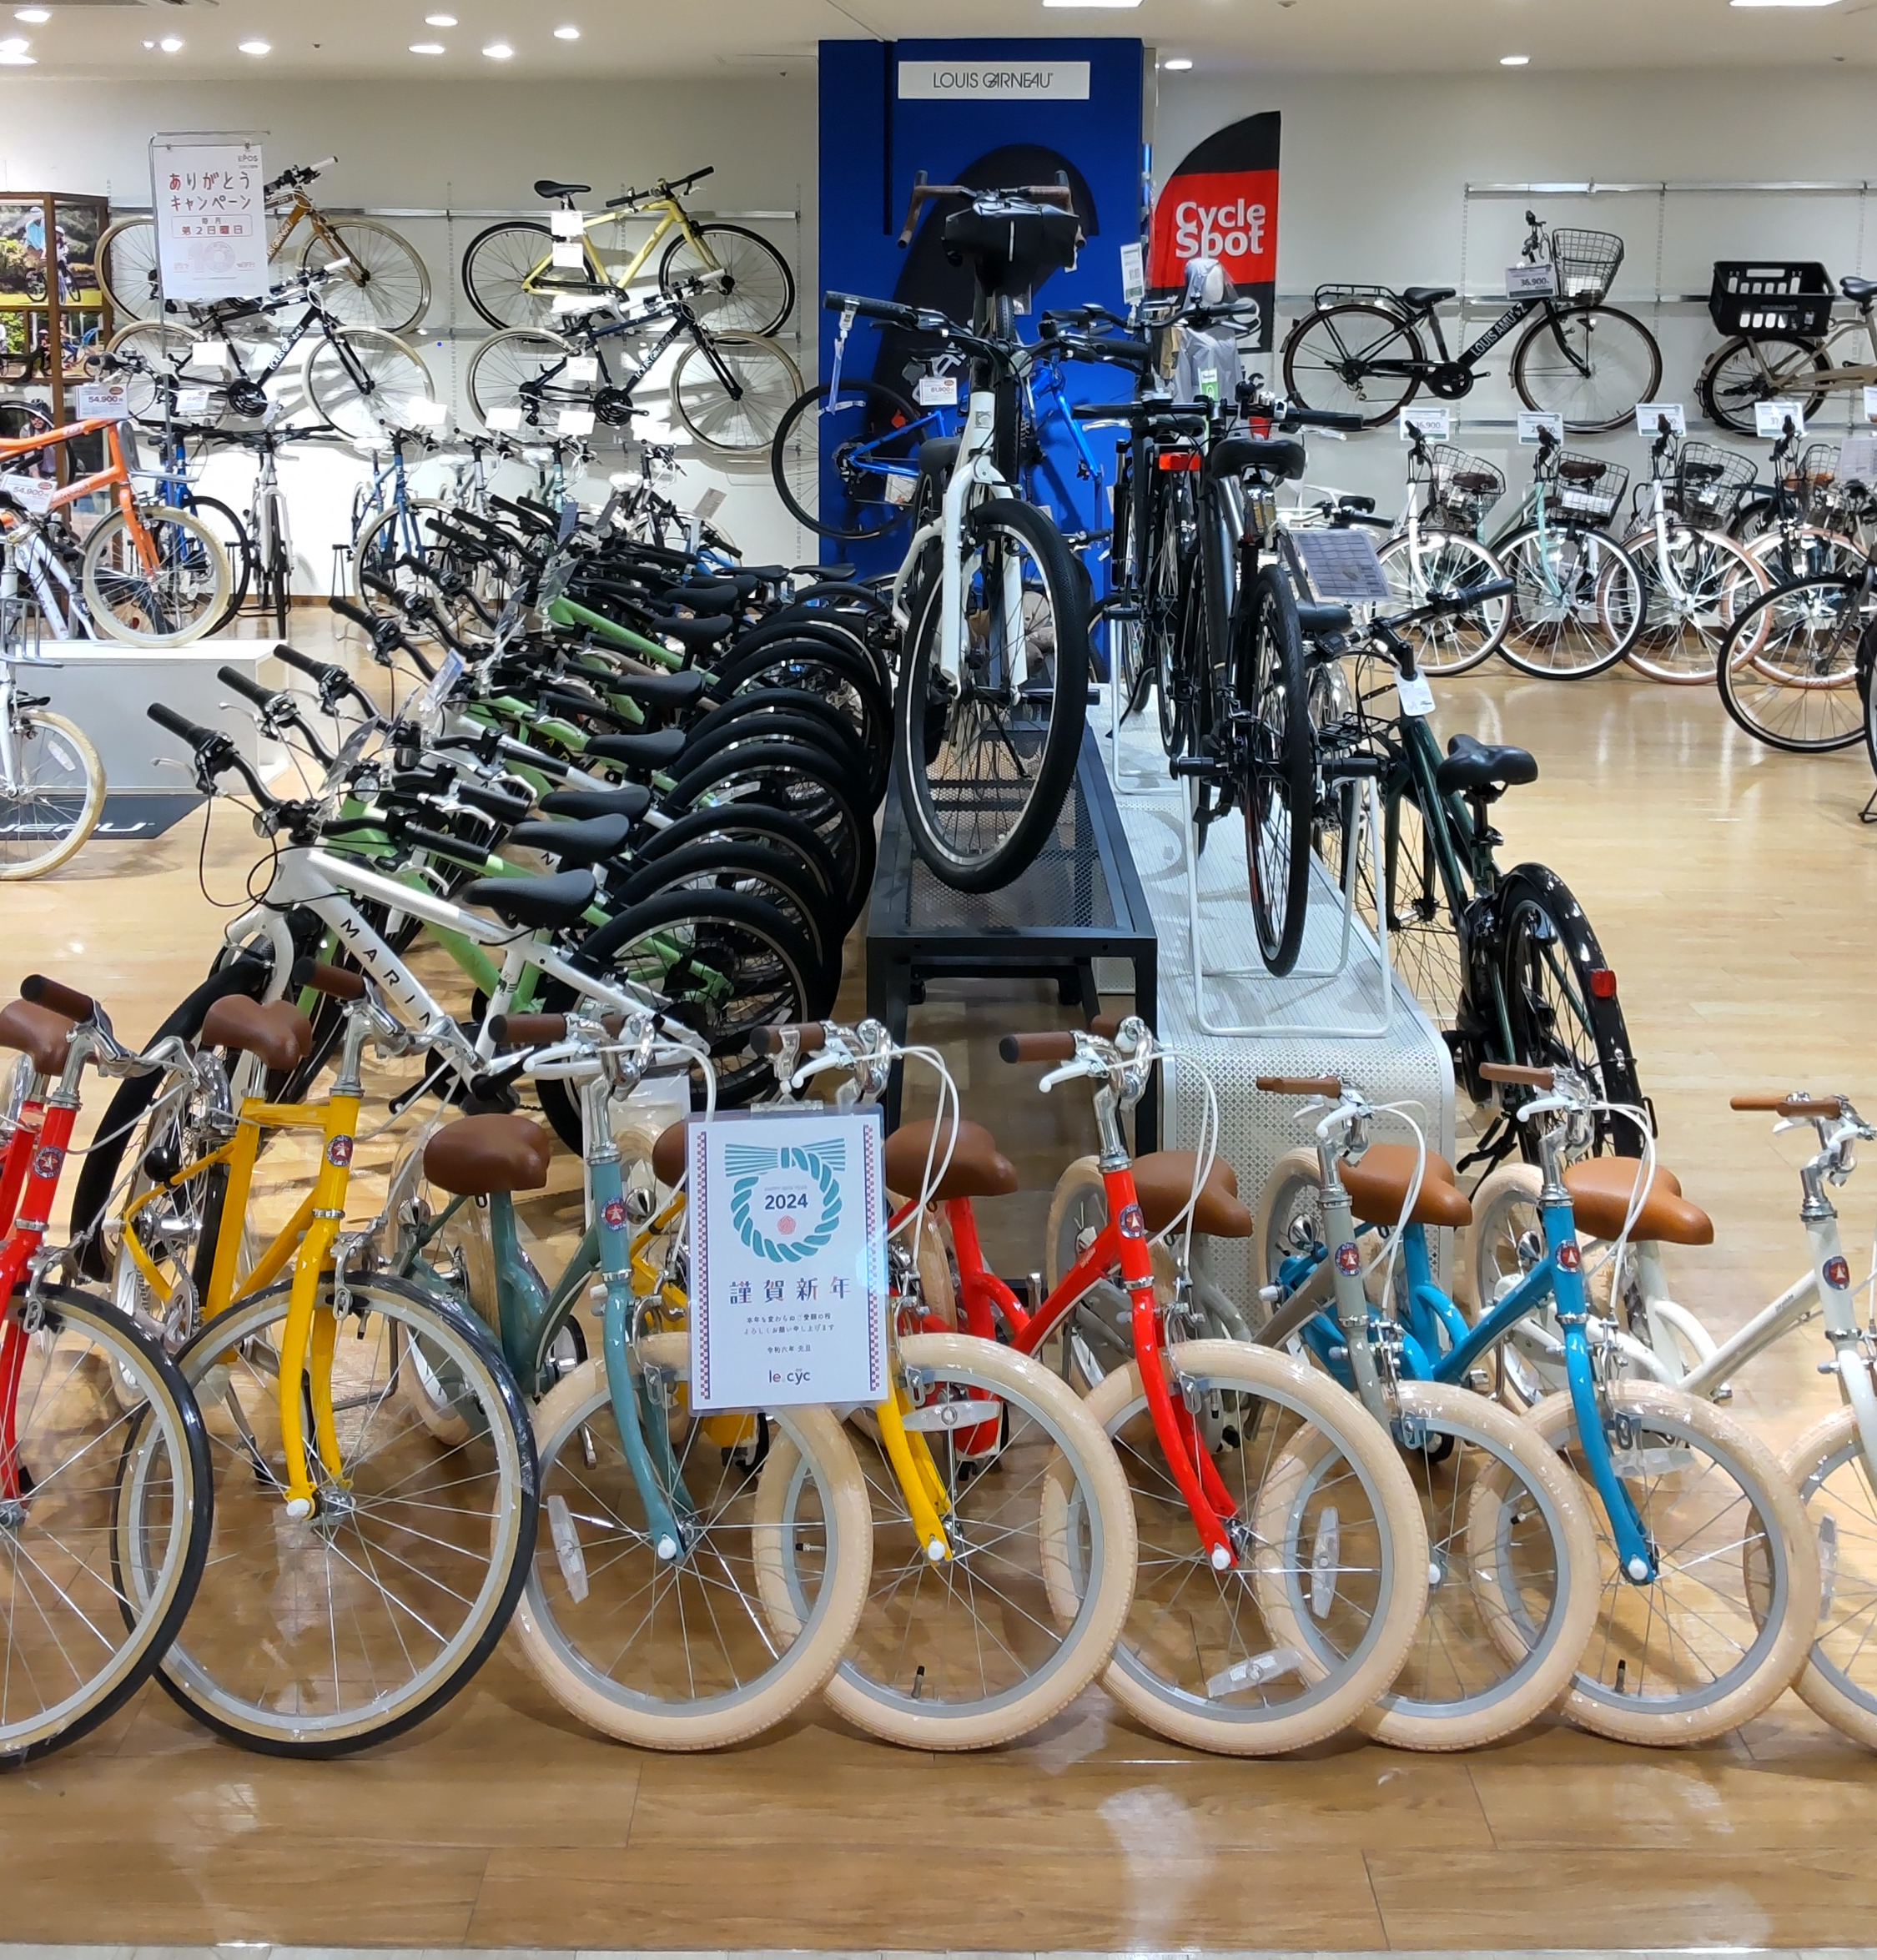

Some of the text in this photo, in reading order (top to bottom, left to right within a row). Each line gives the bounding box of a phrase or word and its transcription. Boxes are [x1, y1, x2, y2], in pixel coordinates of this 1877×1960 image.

[933, 72, 1050, 88] LOUIS GARNEAU
[169, 171, 249, 191] ありがとう
[171, 195, 251, 212] キャンペーン
[1175, 199, 1266, 229] Cycle
[1175, 225, 1264, 258] Spot
[1470, 330, 1498, 357] LOUIS
[765, 1194, 808, 1209] 2024
[730, 1276, 851, 1304] 謹賀新年
